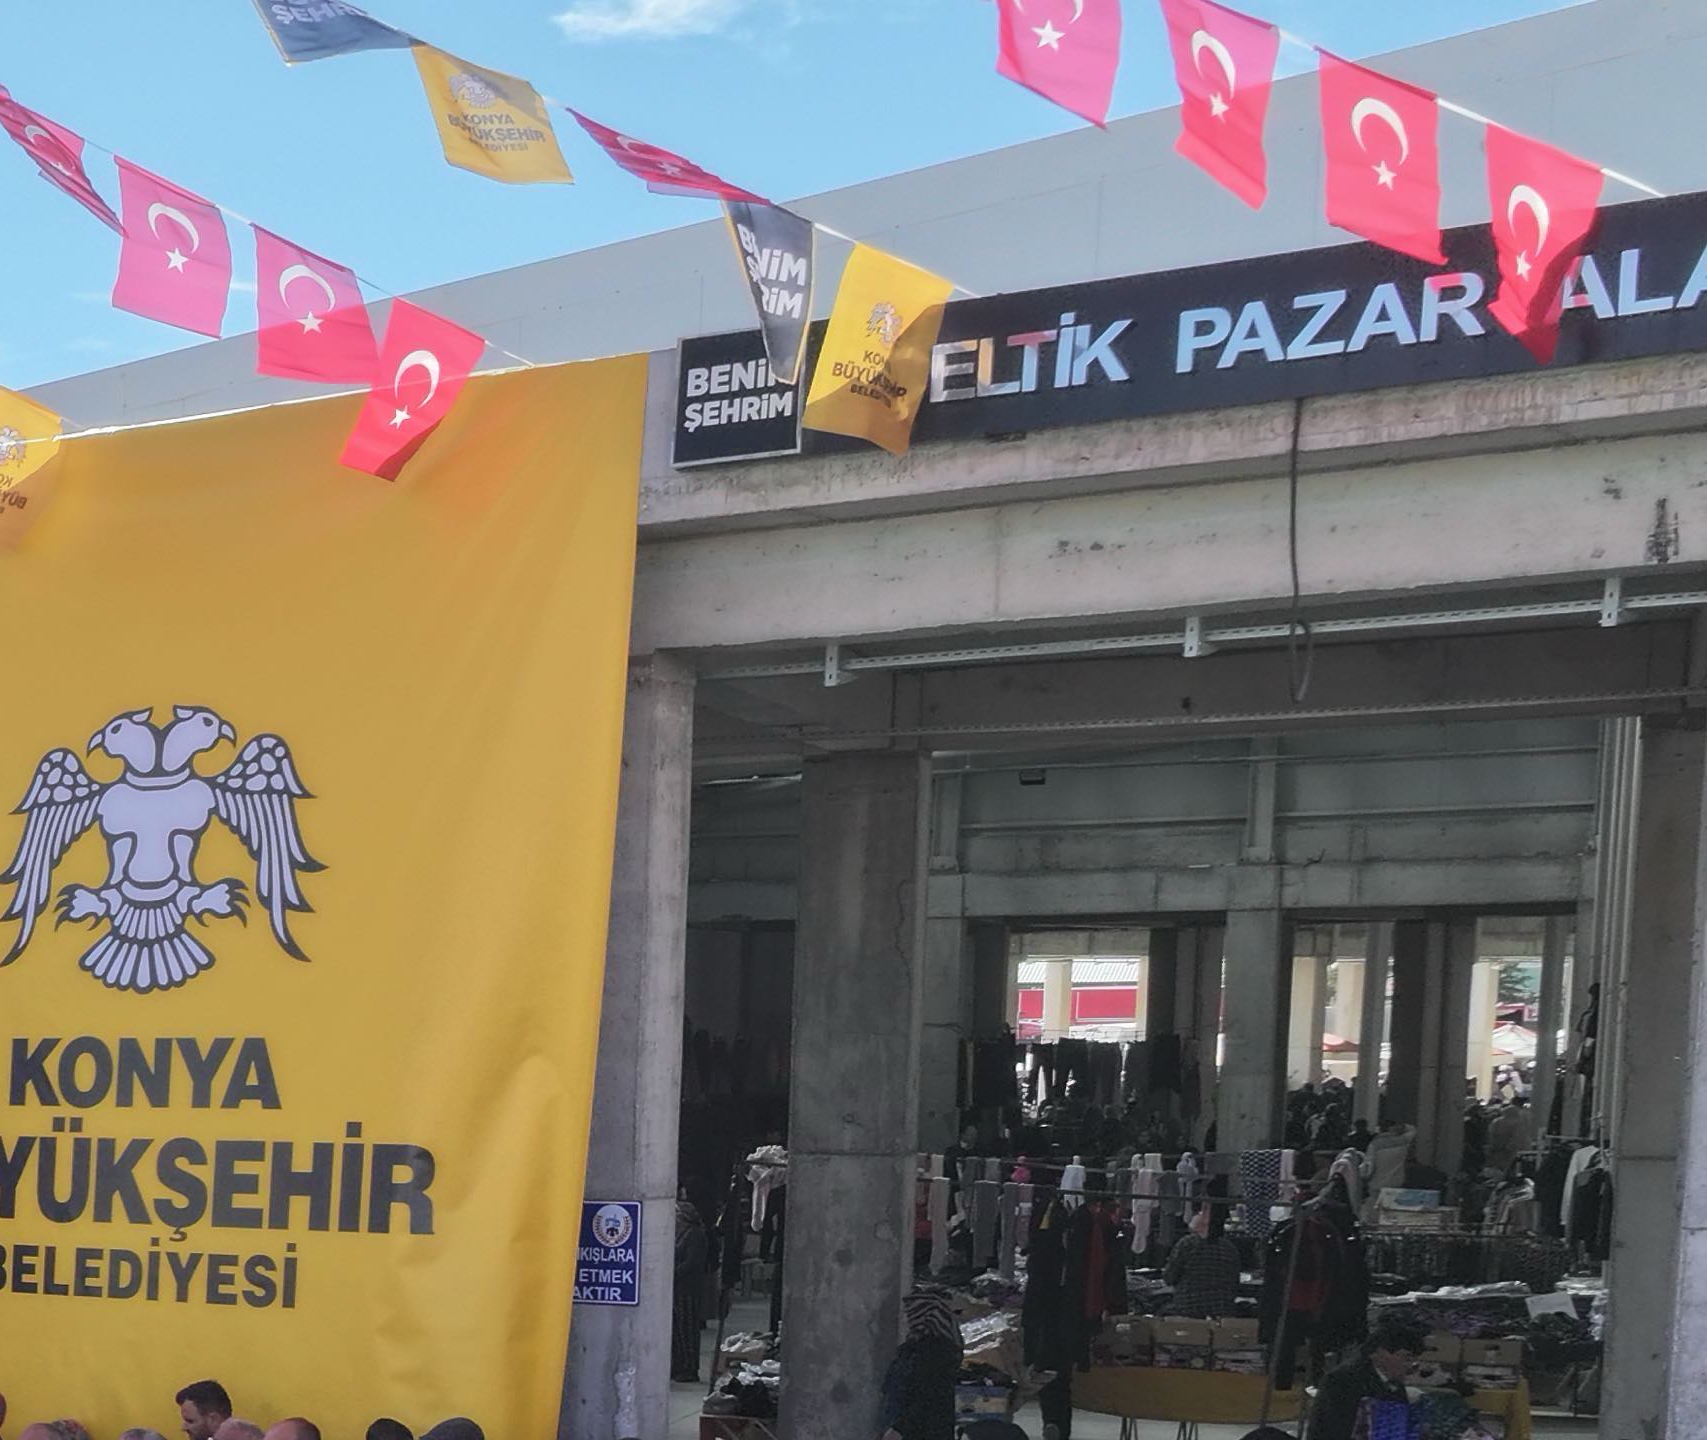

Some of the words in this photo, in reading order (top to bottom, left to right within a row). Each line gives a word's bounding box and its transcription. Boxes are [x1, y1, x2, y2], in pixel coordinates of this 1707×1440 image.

[928, 312, 1133, 404] ELTİK
[1175, 271, 1486, 376] PAZAR
[686, 358, 783, 397] BENİ
[684, 391, 793, 433] ŞEHRİM
[8, 1036, 282, 1110] KONYA
[573, 1286, 621, 1300] AKTIR
[579, 1268, 633, 1284] ETMEK
